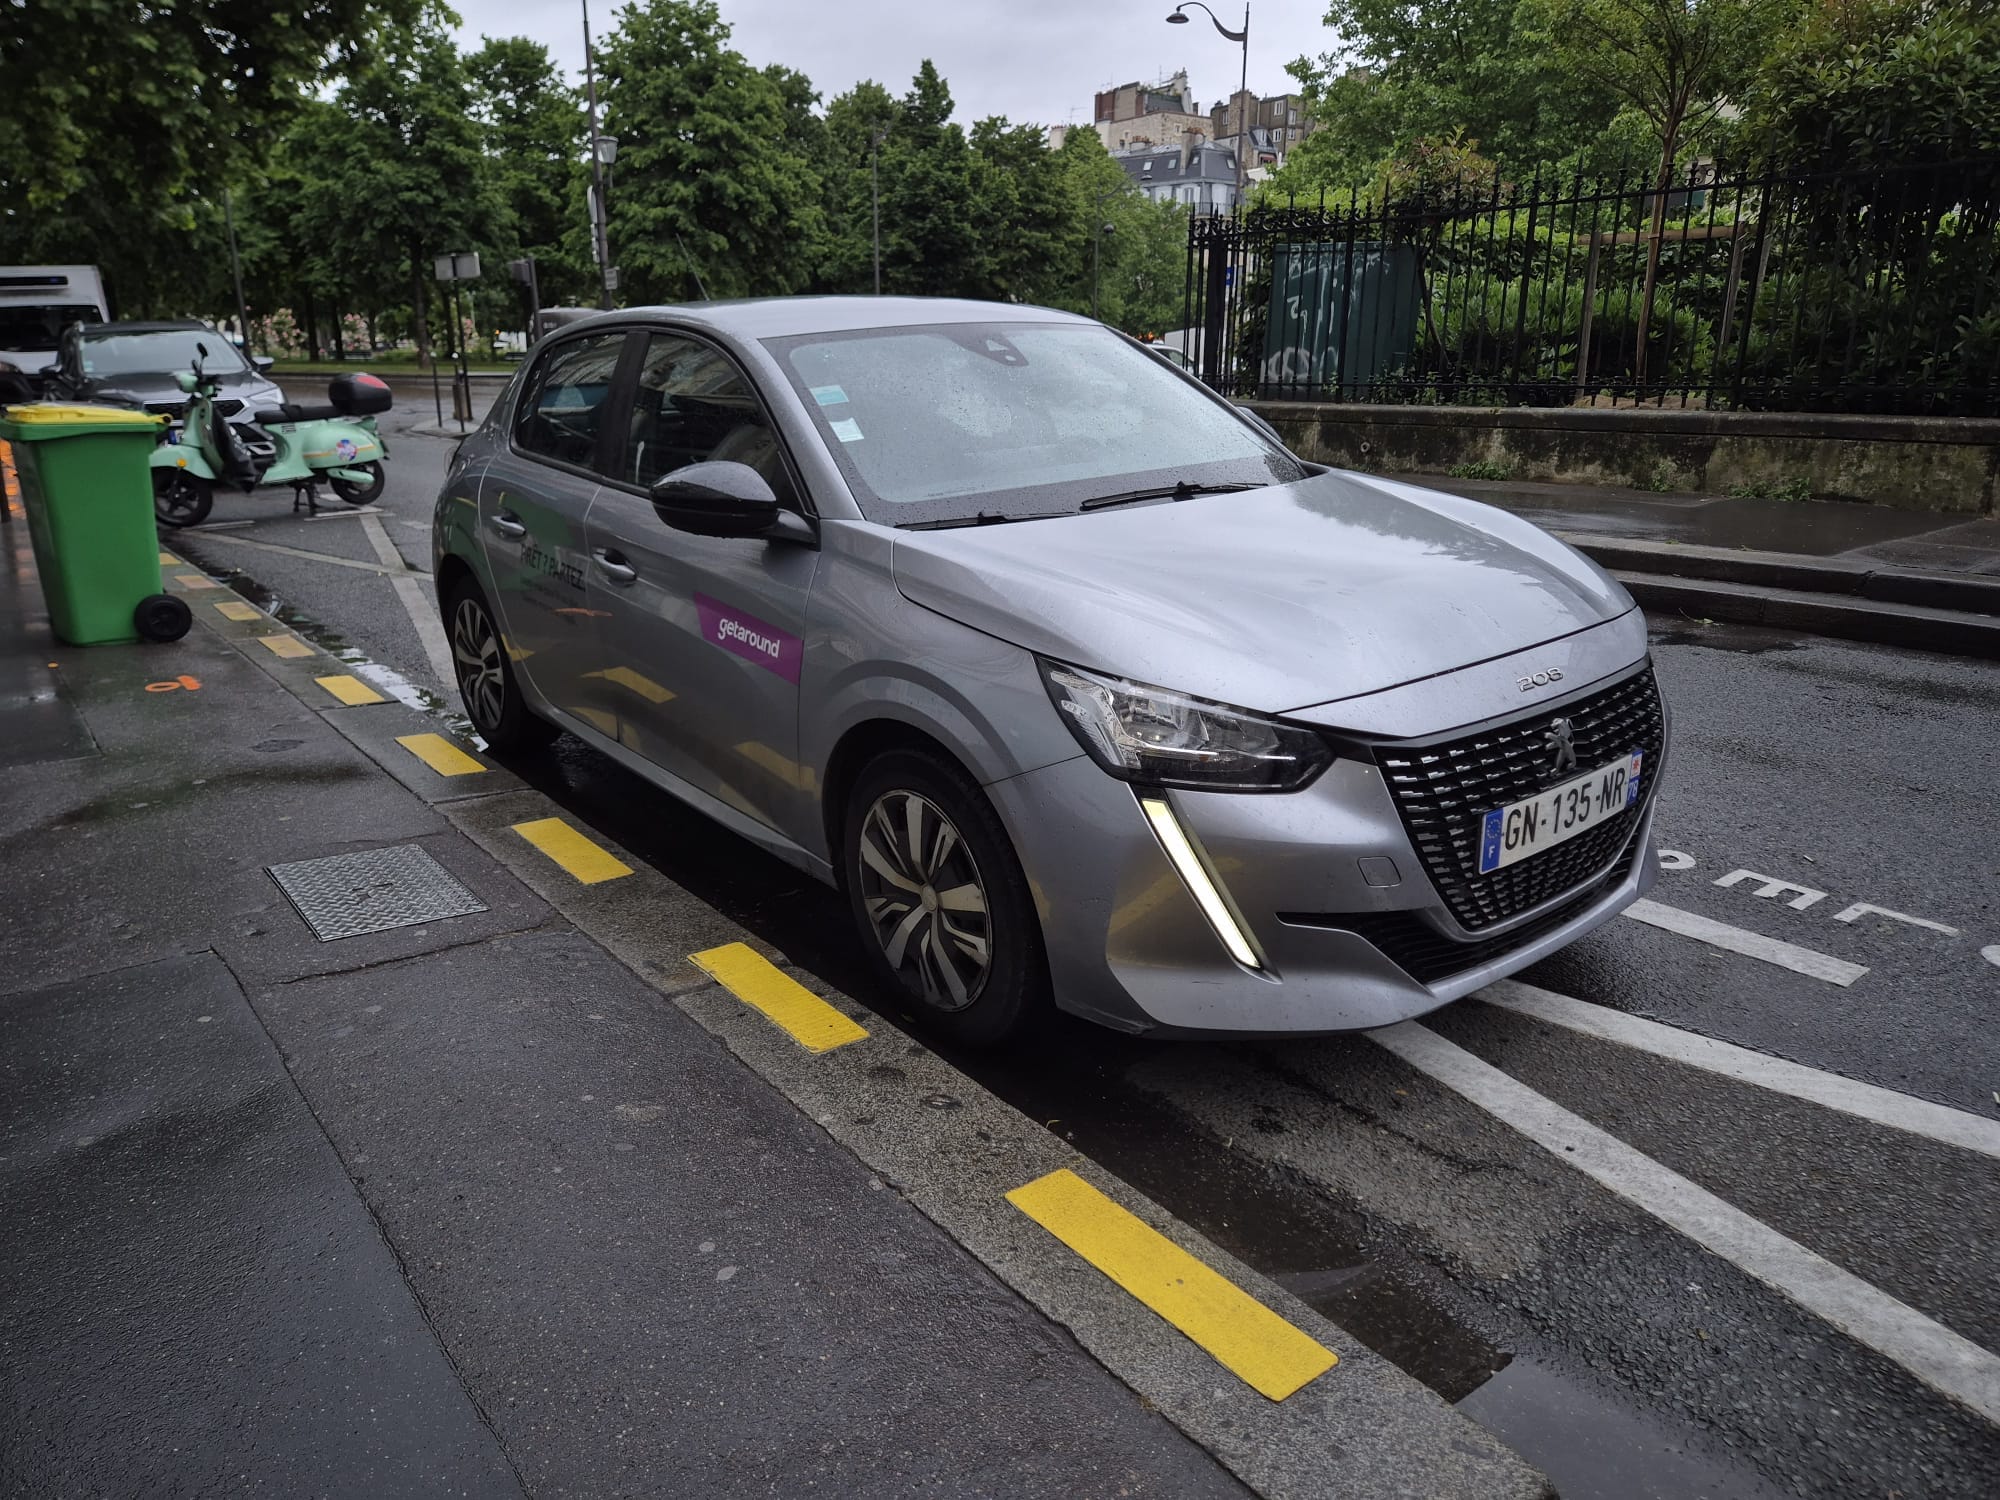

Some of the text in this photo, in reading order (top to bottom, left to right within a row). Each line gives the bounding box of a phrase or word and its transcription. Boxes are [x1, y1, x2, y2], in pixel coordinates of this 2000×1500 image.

[520, 543, 544, 570] PRÊT
[543, 554, 549, 575] ?
[718, 618, 780, 658] getaround
[1516, 667, 1564, 692] 208
[1628, 778, 1640, 801] 78
[1487, 845, 1496, 859] F
